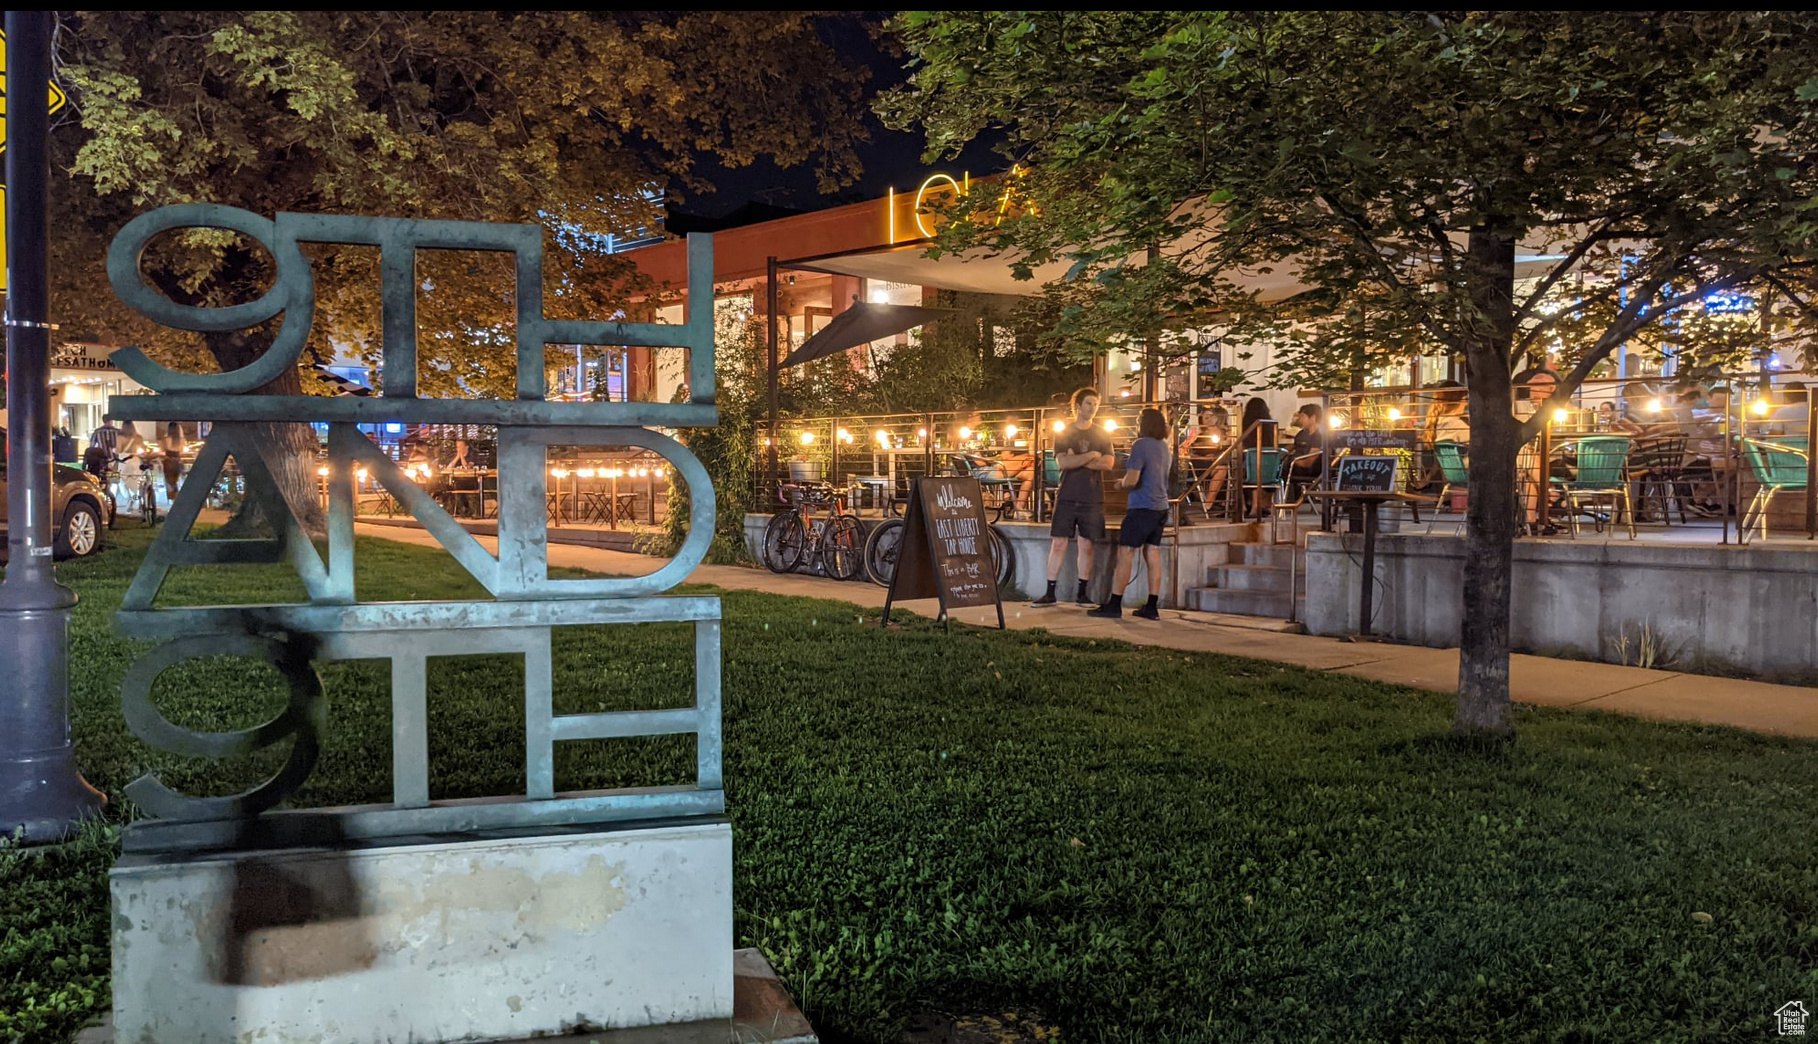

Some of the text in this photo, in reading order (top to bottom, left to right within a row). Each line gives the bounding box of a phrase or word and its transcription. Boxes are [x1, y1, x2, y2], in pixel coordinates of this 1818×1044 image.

[107, 203, 714, 403] 9TH
[1343, 460, 1391, 476] TAKEOUT
[936, 484, 973, 511] Welcome
[121, 422, 717, 610] AND
[936, 518, 980, 538] EAST LIBERTY
[945, 537, 978, 556] TAP HOUSE
[121, 623, 723, 818] 9TH
